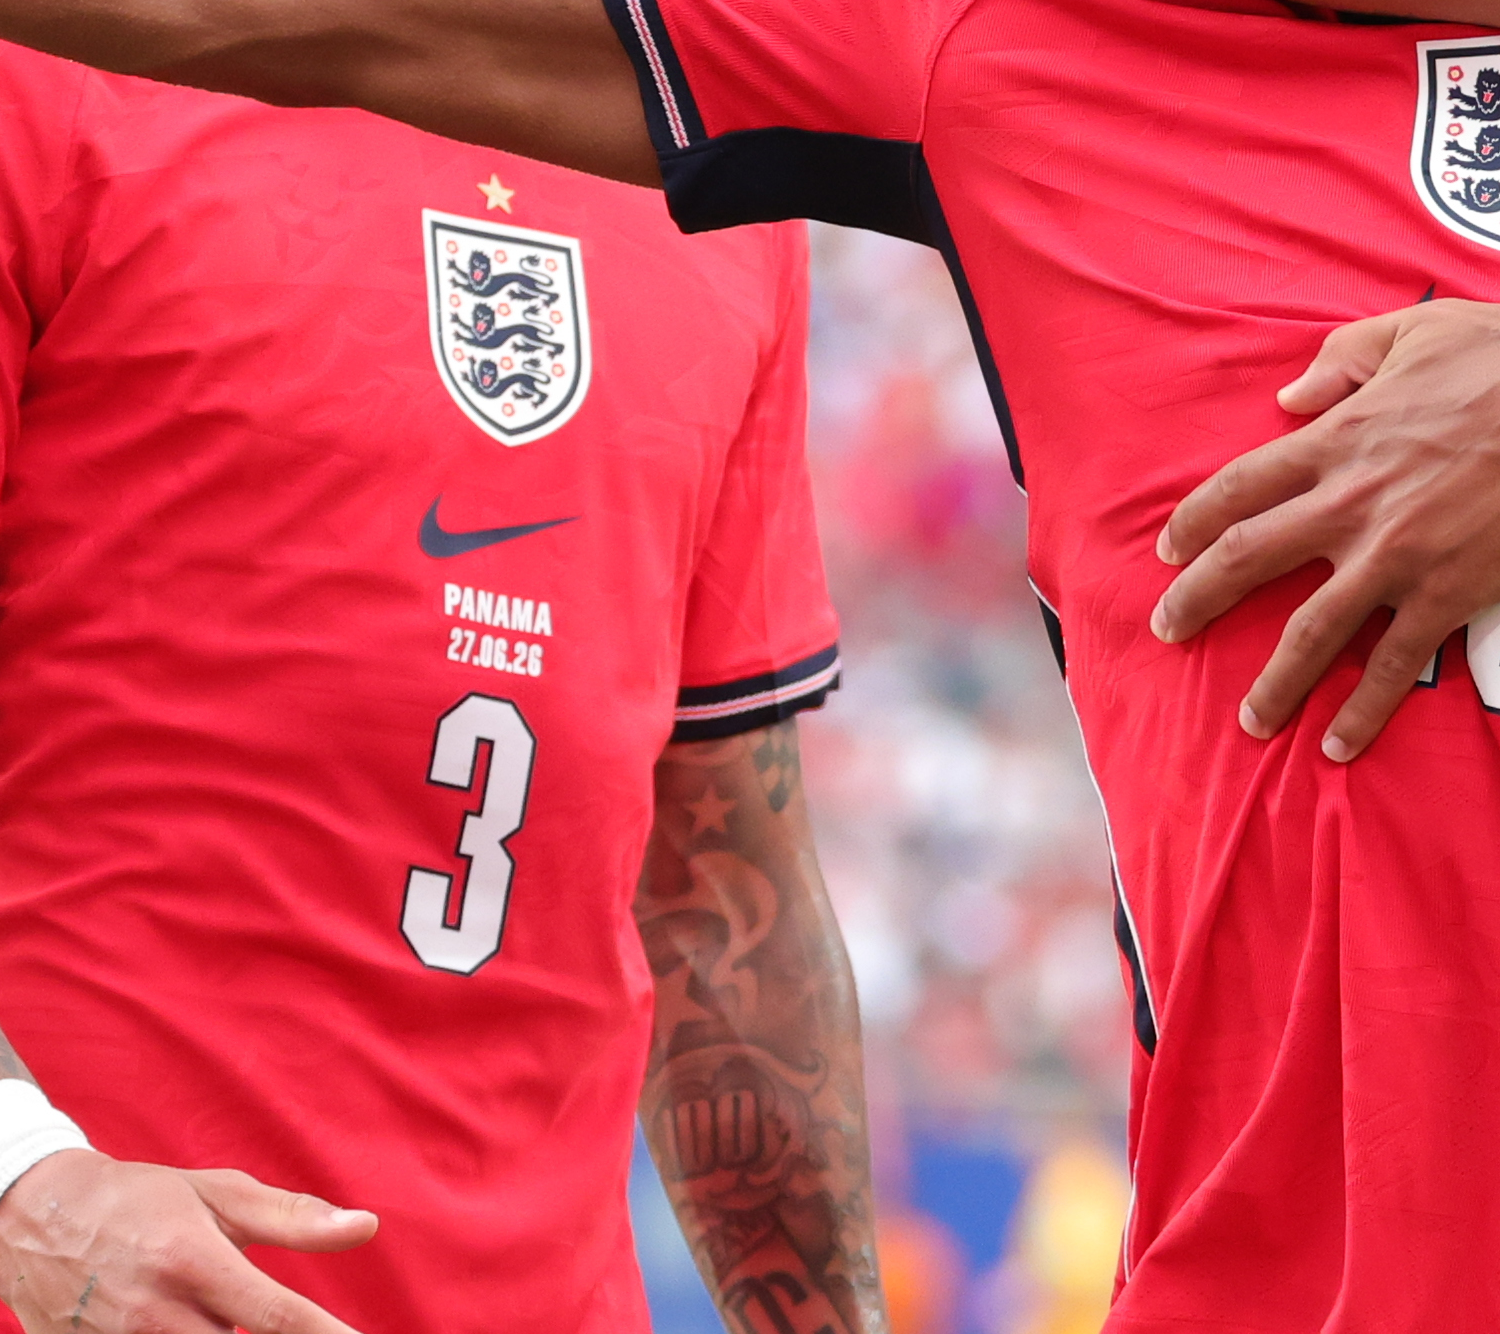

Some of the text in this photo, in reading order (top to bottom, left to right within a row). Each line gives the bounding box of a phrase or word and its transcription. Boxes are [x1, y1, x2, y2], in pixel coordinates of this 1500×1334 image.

[443, 582, 553, 637] PANAMA
[446, 628, 543, 677] 27.06.26
[400, 691, 537, 978] 3
